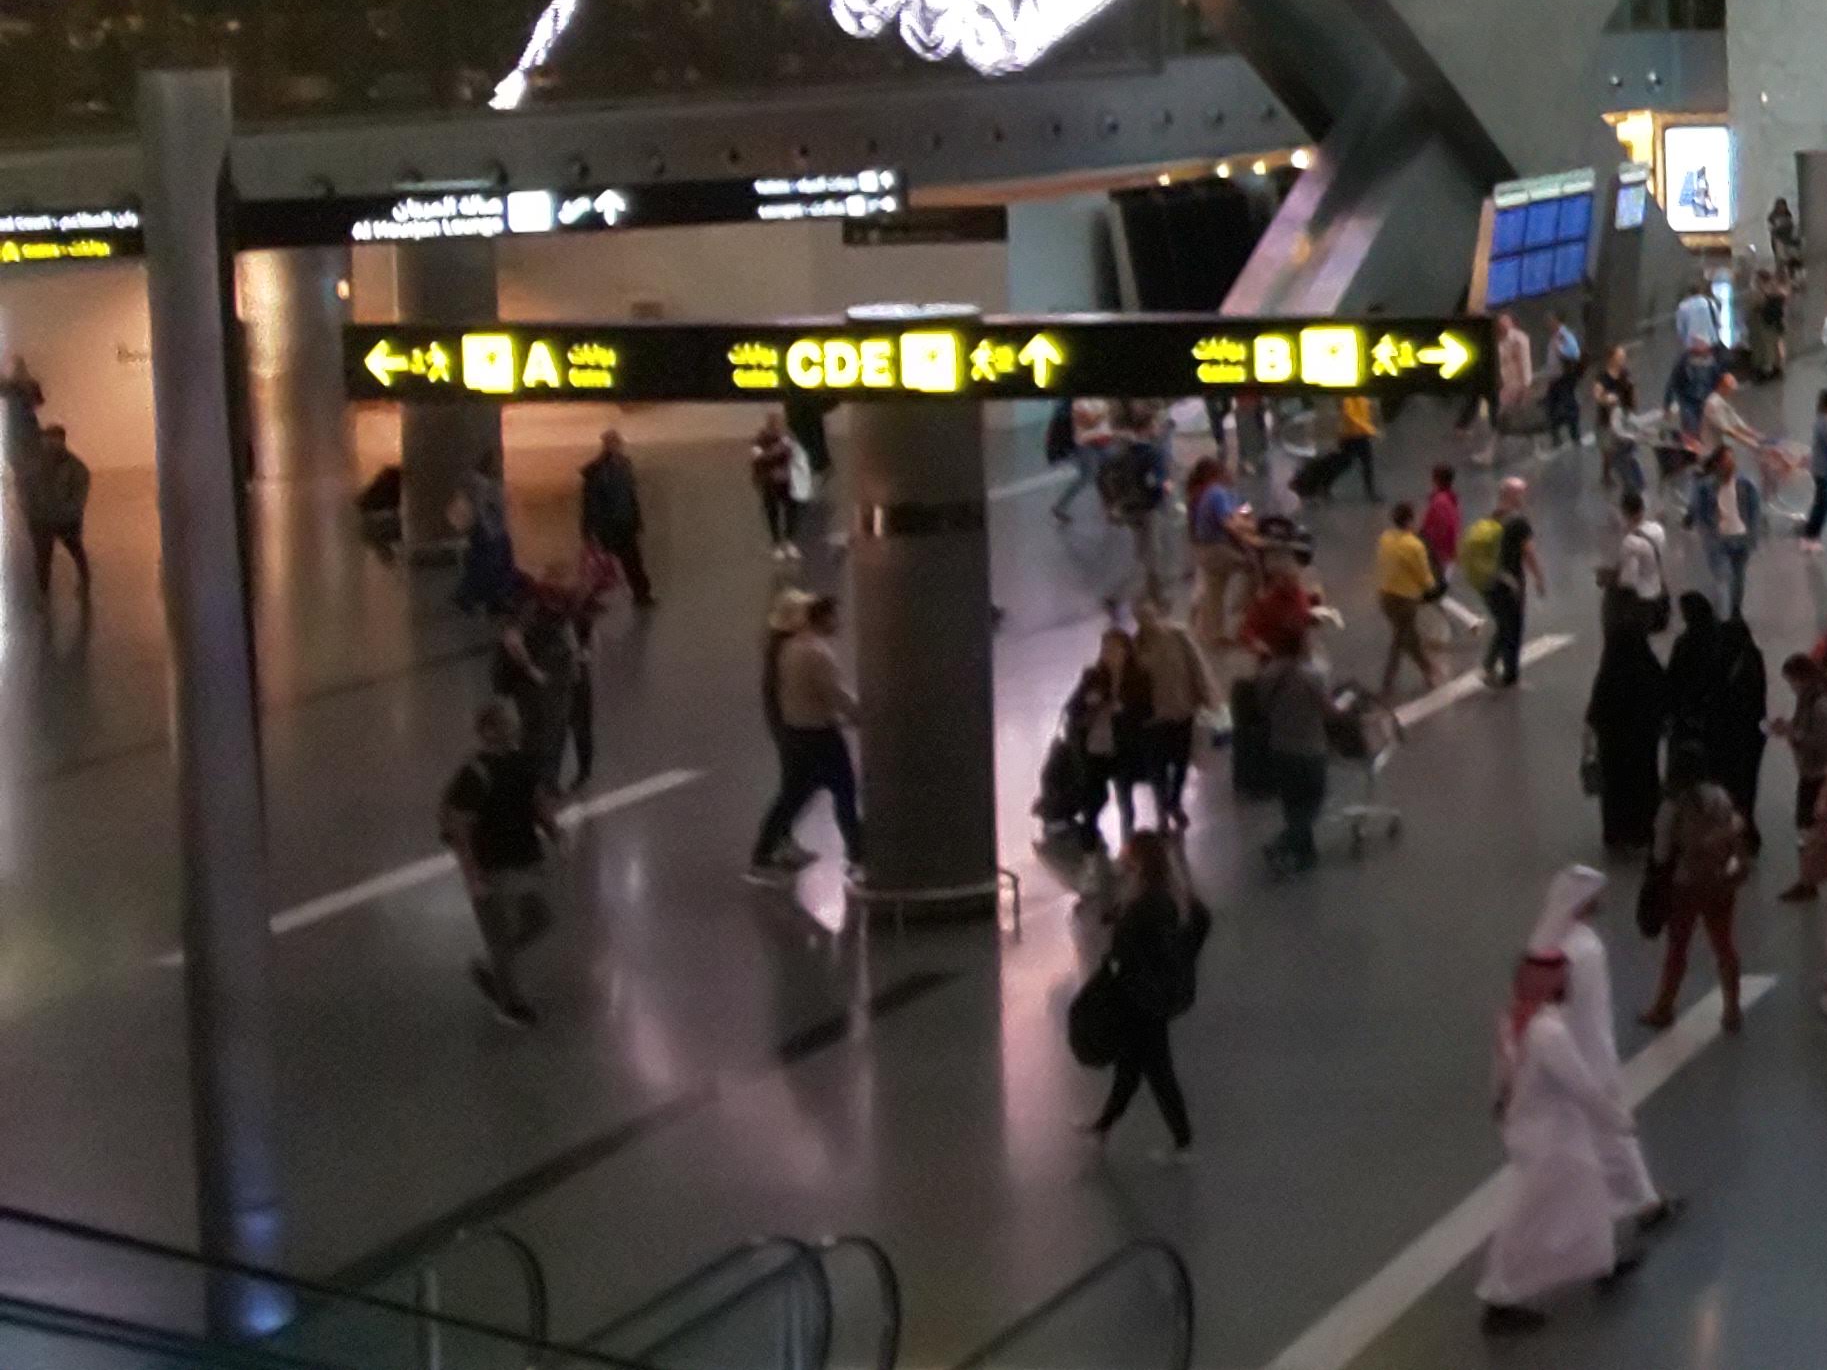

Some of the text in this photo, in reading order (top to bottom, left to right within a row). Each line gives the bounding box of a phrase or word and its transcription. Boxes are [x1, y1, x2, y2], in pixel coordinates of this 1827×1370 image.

[521, 341, 561, 388] A
[786, 339, 895, 388] CDE
[1254, 334, 1294, 382] B
